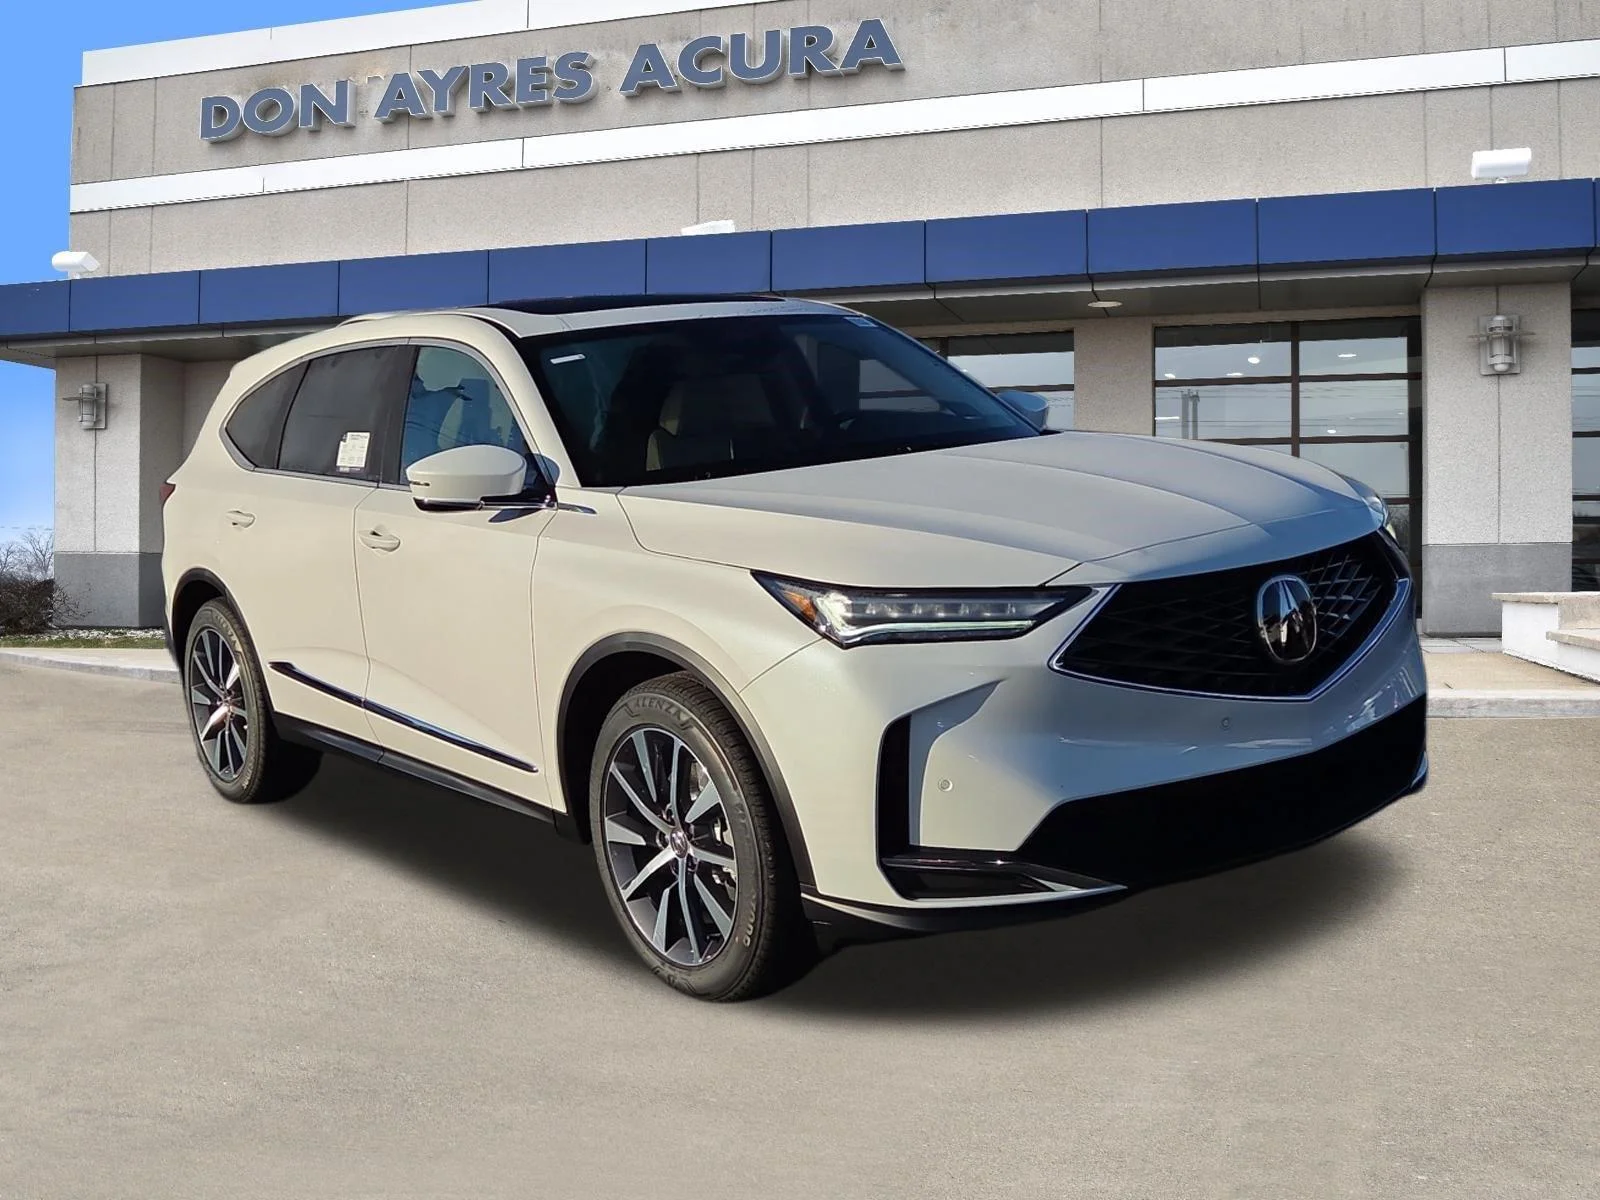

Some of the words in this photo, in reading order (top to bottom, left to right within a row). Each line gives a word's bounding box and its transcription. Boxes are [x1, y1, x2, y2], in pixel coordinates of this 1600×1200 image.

[200, 80, 354, 142] DON
[374, 50, 595, 122] AYRES
[619, 18, 905, 96] ACURA
